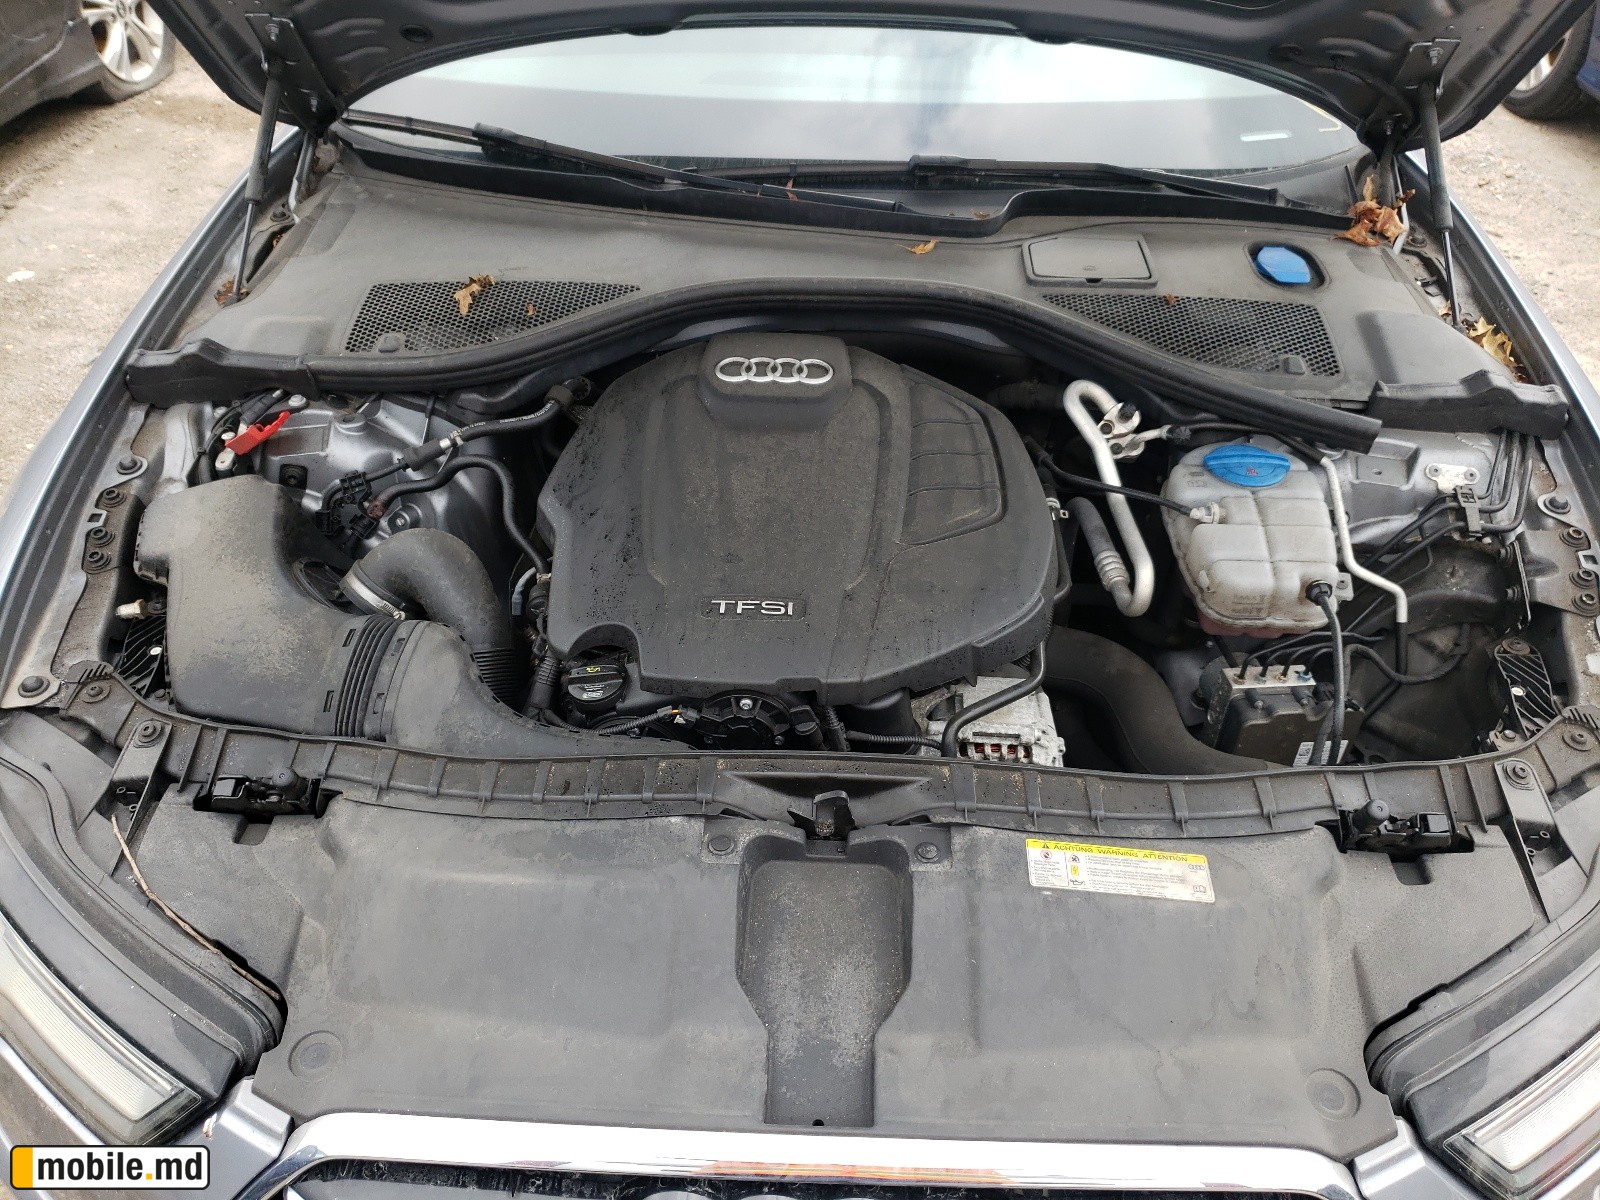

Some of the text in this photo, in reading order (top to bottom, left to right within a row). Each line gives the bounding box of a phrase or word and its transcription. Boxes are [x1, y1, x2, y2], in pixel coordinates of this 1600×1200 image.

[711, 600, 793, 615] TFSI
[1053, 844, 1188, 862] ACHTUNG WARNING ATTENTION
